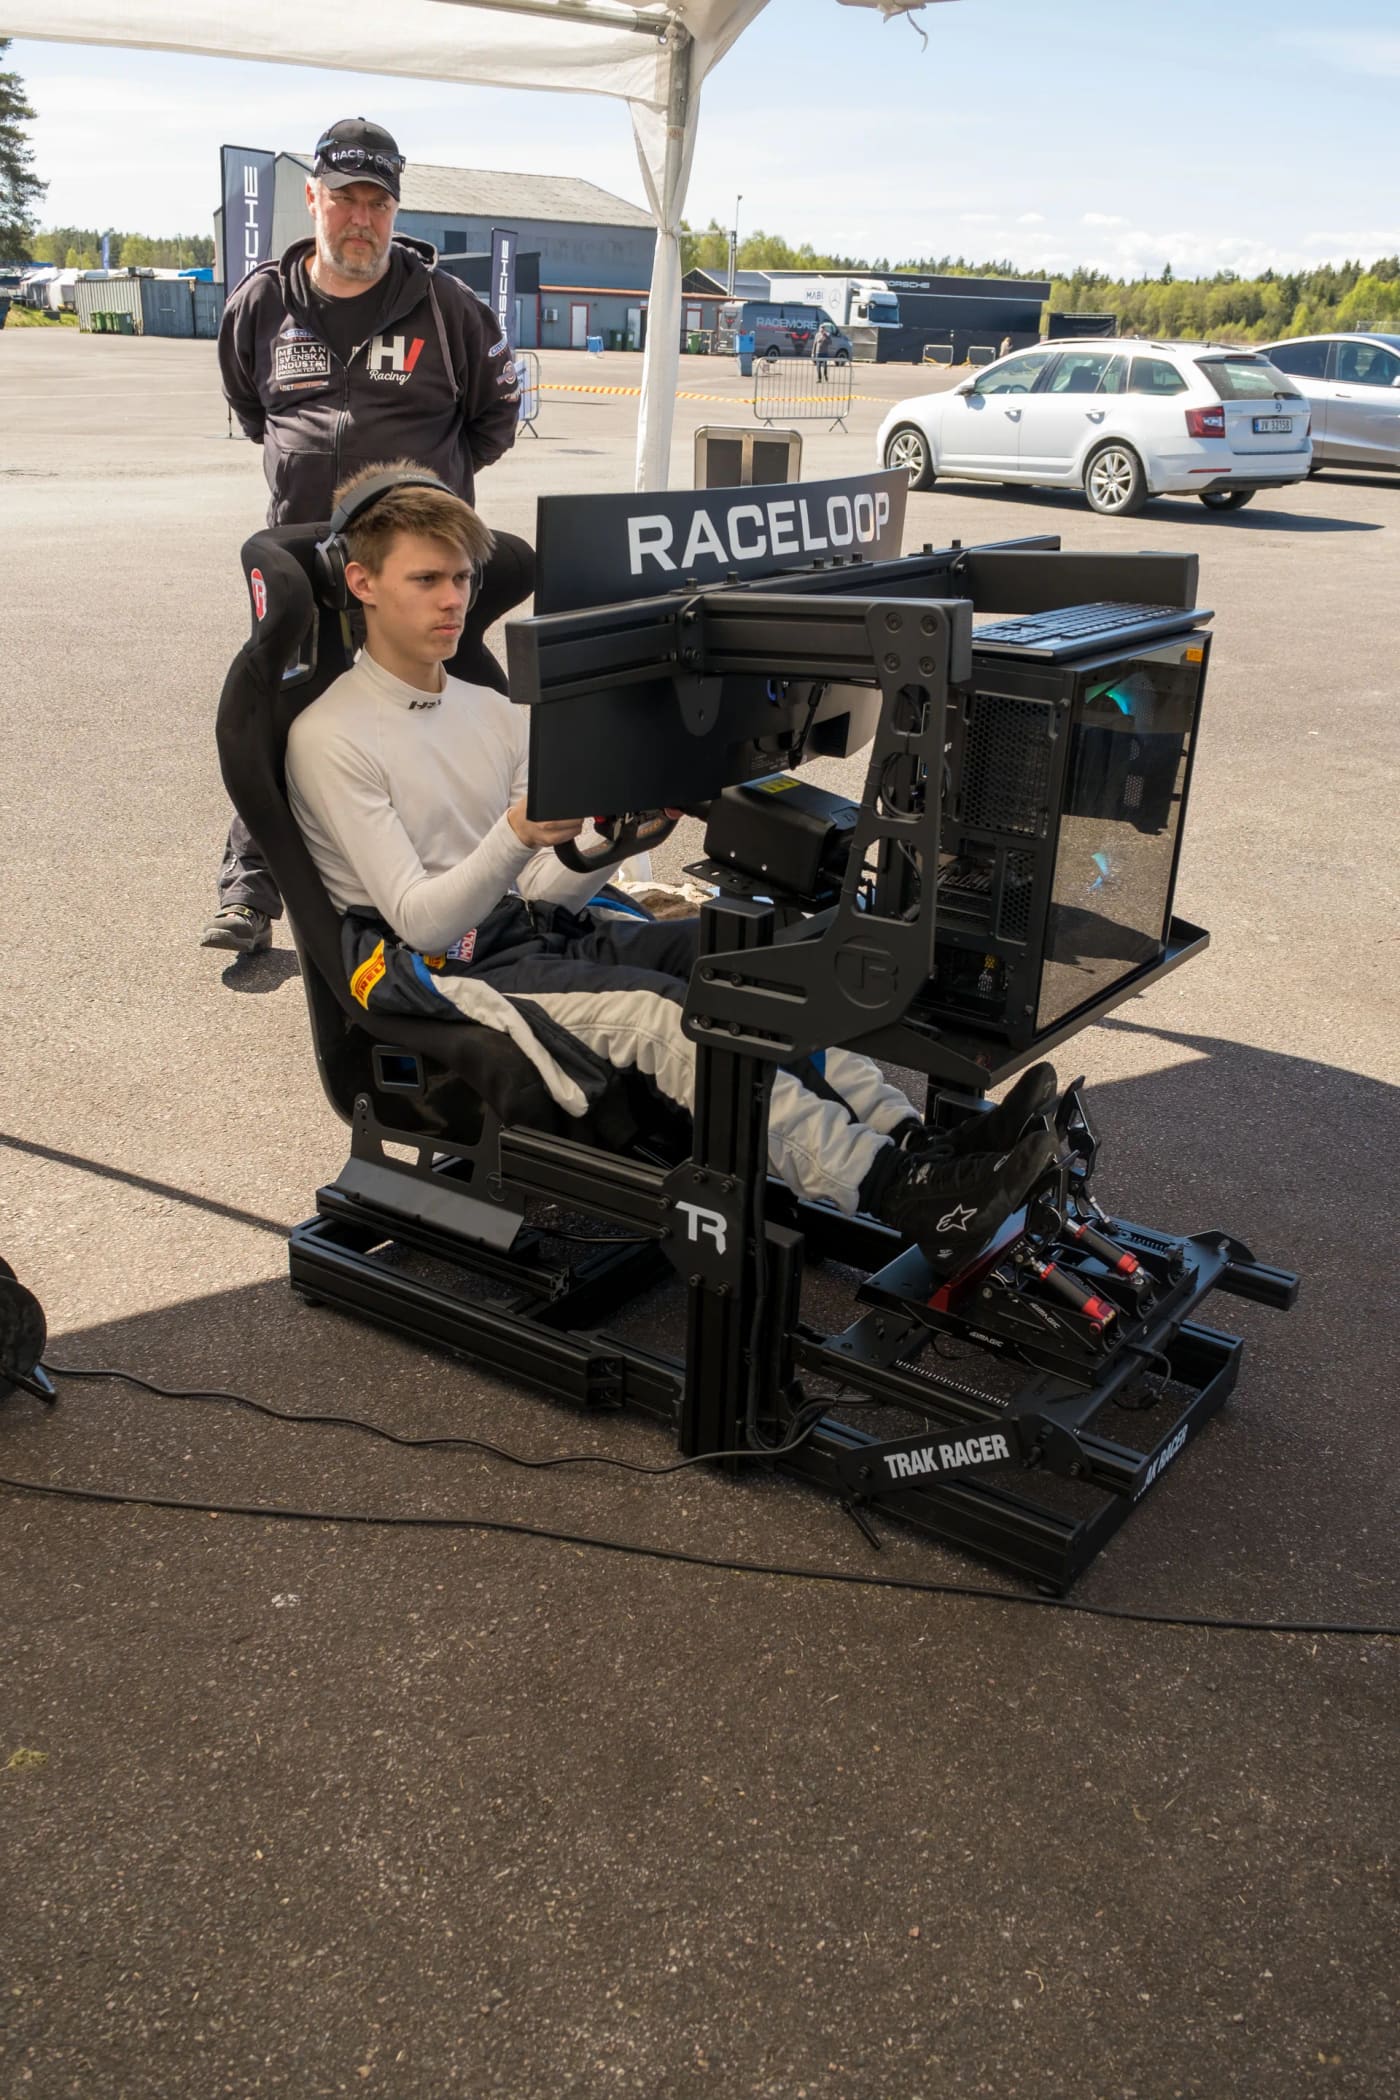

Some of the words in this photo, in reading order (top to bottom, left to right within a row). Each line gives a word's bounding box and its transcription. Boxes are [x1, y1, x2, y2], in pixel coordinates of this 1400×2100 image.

[756, 316, 818, 331] RACEMORE
[279, 345, 327, 357] MELLAN
[279, 353, 327, 365] SVENSKA
[279, 360, 327, 372] INDUSTRI
[369, 369, 412, 386] Racing
[627, 492, 890, 575] RACELOOP
[675, 1200, 728, 1255] TR
[883, 1447, 940, 1479] TRAK
[938, 1434, 1010, 1470] RACER
